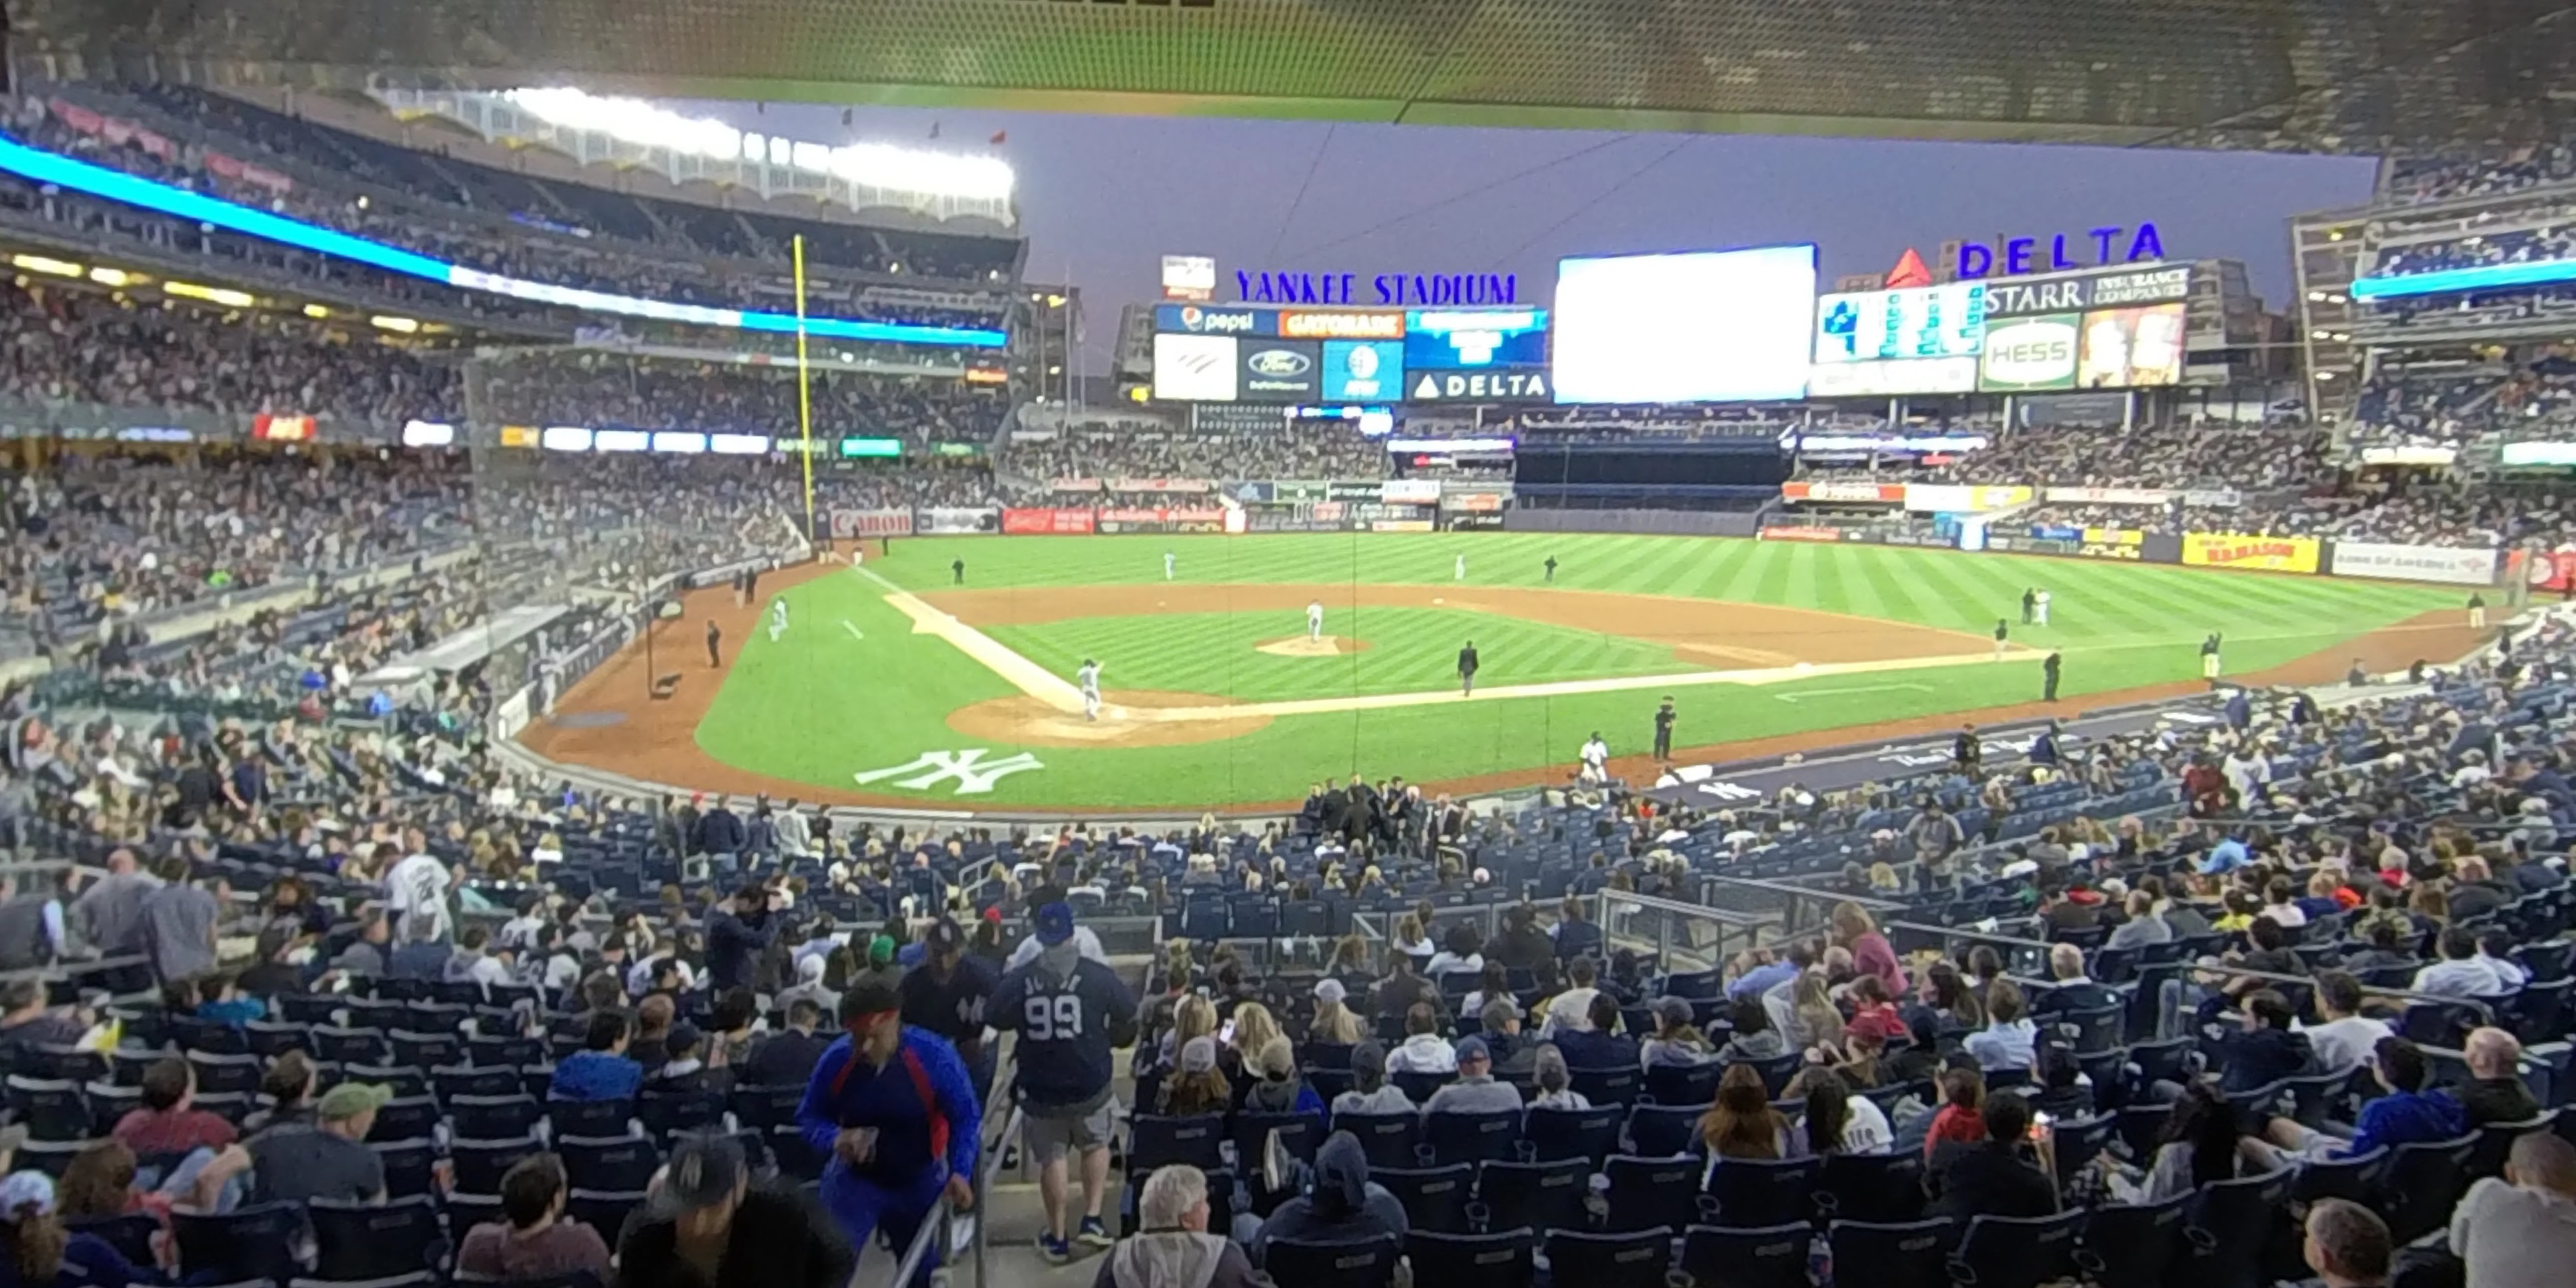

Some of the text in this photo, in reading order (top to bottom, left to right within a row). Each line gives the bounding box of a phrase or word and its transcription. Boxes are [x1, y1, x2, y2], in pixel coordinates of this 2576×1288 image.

[1957, 221, 2164, 279] DELTA
[1236, 269, 1516, 305] YANKEE STADIUM
[1986, 282, 2083, 313] STARR
[1204, 312, 1254, 332] pepsi
[1286, 314, 1399, 337] GATORADE
[1260, 352, 1297, 372] Ford
[1992, 340, 2069, 364] HESS
[1447, 374, 1545, 397] DELTA
[833, 512, 910, 533] Canon
[1024, 994, 1083, 1041] 99
